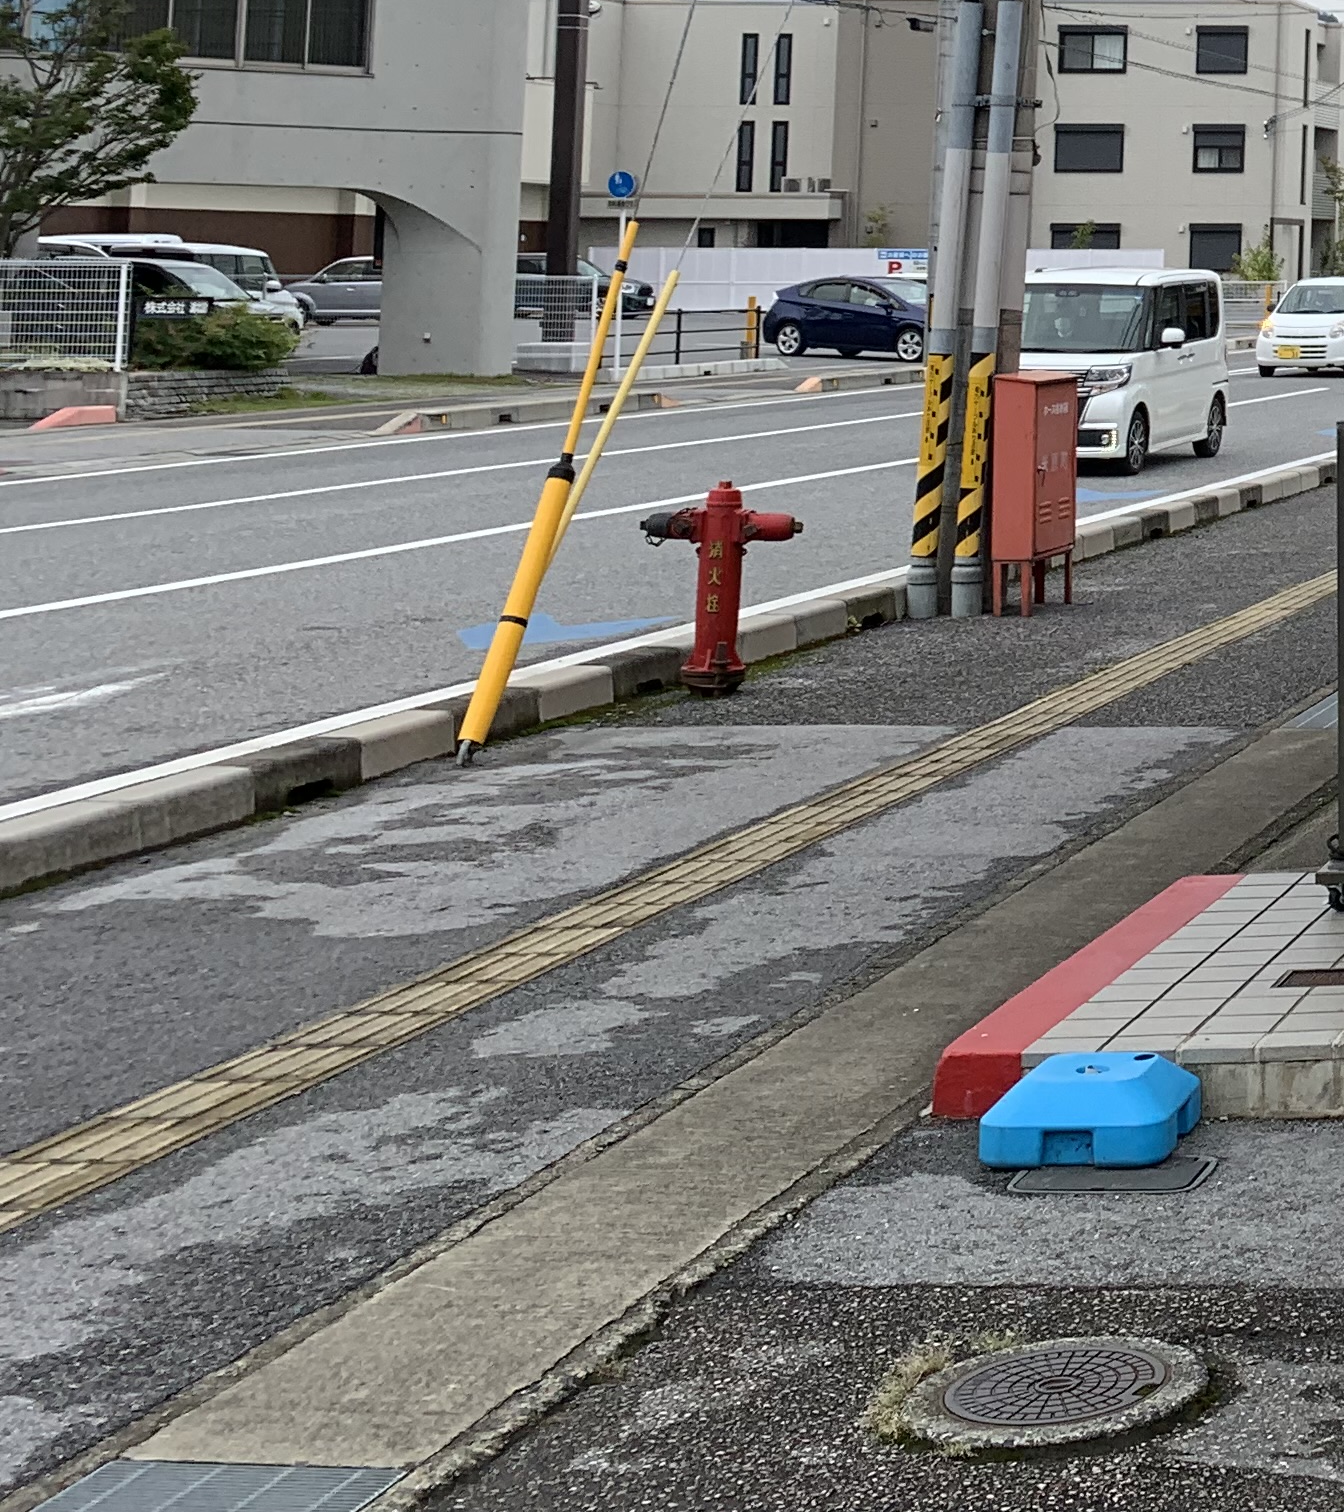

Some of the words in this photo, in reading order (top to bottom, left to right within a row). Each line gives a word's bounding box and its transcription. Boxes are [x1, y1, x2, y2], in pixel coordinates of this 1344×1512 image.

[888, 261, 902, 274] P
[706, 540, 723, 612] 消火栓
